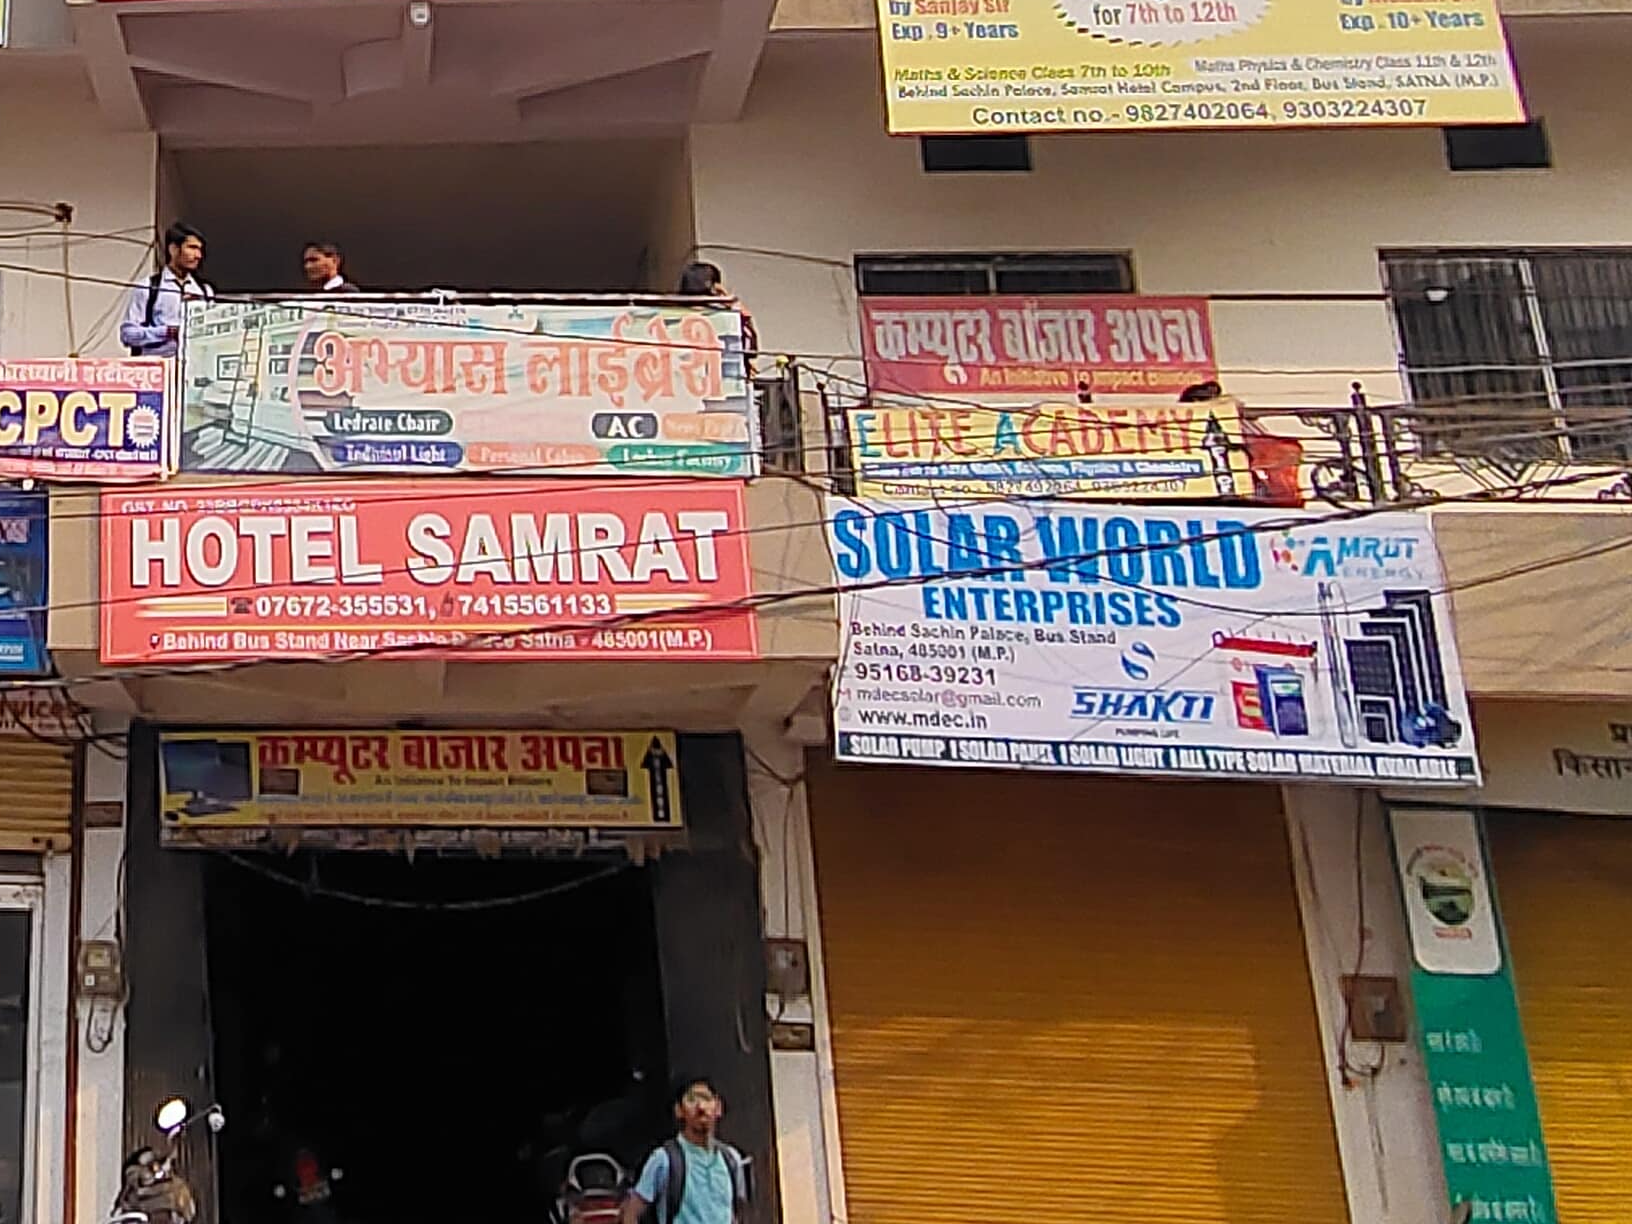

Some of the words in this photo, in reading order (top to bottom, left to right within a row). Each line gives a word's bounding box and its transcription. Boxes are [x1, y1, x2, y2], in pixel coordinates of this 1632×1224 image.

[1093, 4, 1121, 25] for
[1126, 3, 1159, 24] 7th
[1164, 5, 1185, 24] to
[1191, 1, 1237, 22] 12th
[1425, 10, 1485, 27] Years
[964, 21, 1019, 38] Years
[947, 66, 961, 80] &
[1080, 65, 1106, 78] 7th
[1112, 65, 1128, 78] to
[898, 85, 947, 98] Behind
[951, 85, 999, 97] Sachin
[1230, 78, 1260, 92] 2nd
[1312, 76, 1339, 90] Bus
[1396, 74, 1450, 88] SATNA
[972, 105, 1066, 125] Contact
[1282, 99, 1426, 119] 9303224307
[1105, 309, 1207, 363] अपना
[314, 332, 508, 396] अभ्यास
[397, 413, 440, 431] Chair
[608, 416, 644, 437] AC
[856, 410, 979, 459] ELITE
[994, 406, 1193, 456] ACADEMY
[410, 444, 445, 464] Light
[130, 516, 383, 587] HOTEL
[405, 512, 729, 585] SAMRAT
[834, 510, 1025, 582] SOLAR
[1036, 516, 1262, 590] WORLD
[457, 594, 611, 616] 7415561133
[923, 587, 1182, 628] ENTERPRISES
[163, 632, 227, 650] Behind
[233, 632, 269, 650] Bus
[275, 632, 328, 650] Stand
[334, 632, 378, 650] Near
[851, 622, 905, 639] Behind
[911, 623, 964, 641] Sachin
[1035, 629, 1065, 644] Bus
[1070, 629, 1117, 646] Stand
[854, 642, 904, 660] Satna,
[909, 643, 965, 660] 485001
[972, 645, 1016, 664] (M.P.)
[855, 663, 997, 686] 95168-39231
[857, 688, 1042, 710] mdecsolar@gmail.com
[1071, 691, 1215, 722] SHAKTI
[858, 709, 988, 730] www.mdec.in
[400, 736, 508, 771] बाजार
[520, 736, 624, 771] अपना
[850, 735, 899, 757] SOLAR
[902, 738, 944, 759] PUMP
[960, 740, 1009, 762] SOLAR
[1070, 744, 1118, 766] SOLAR
[1208, 750, 1246, 772] TYPE
[1247, 752, 1298, 774] SOLAR
